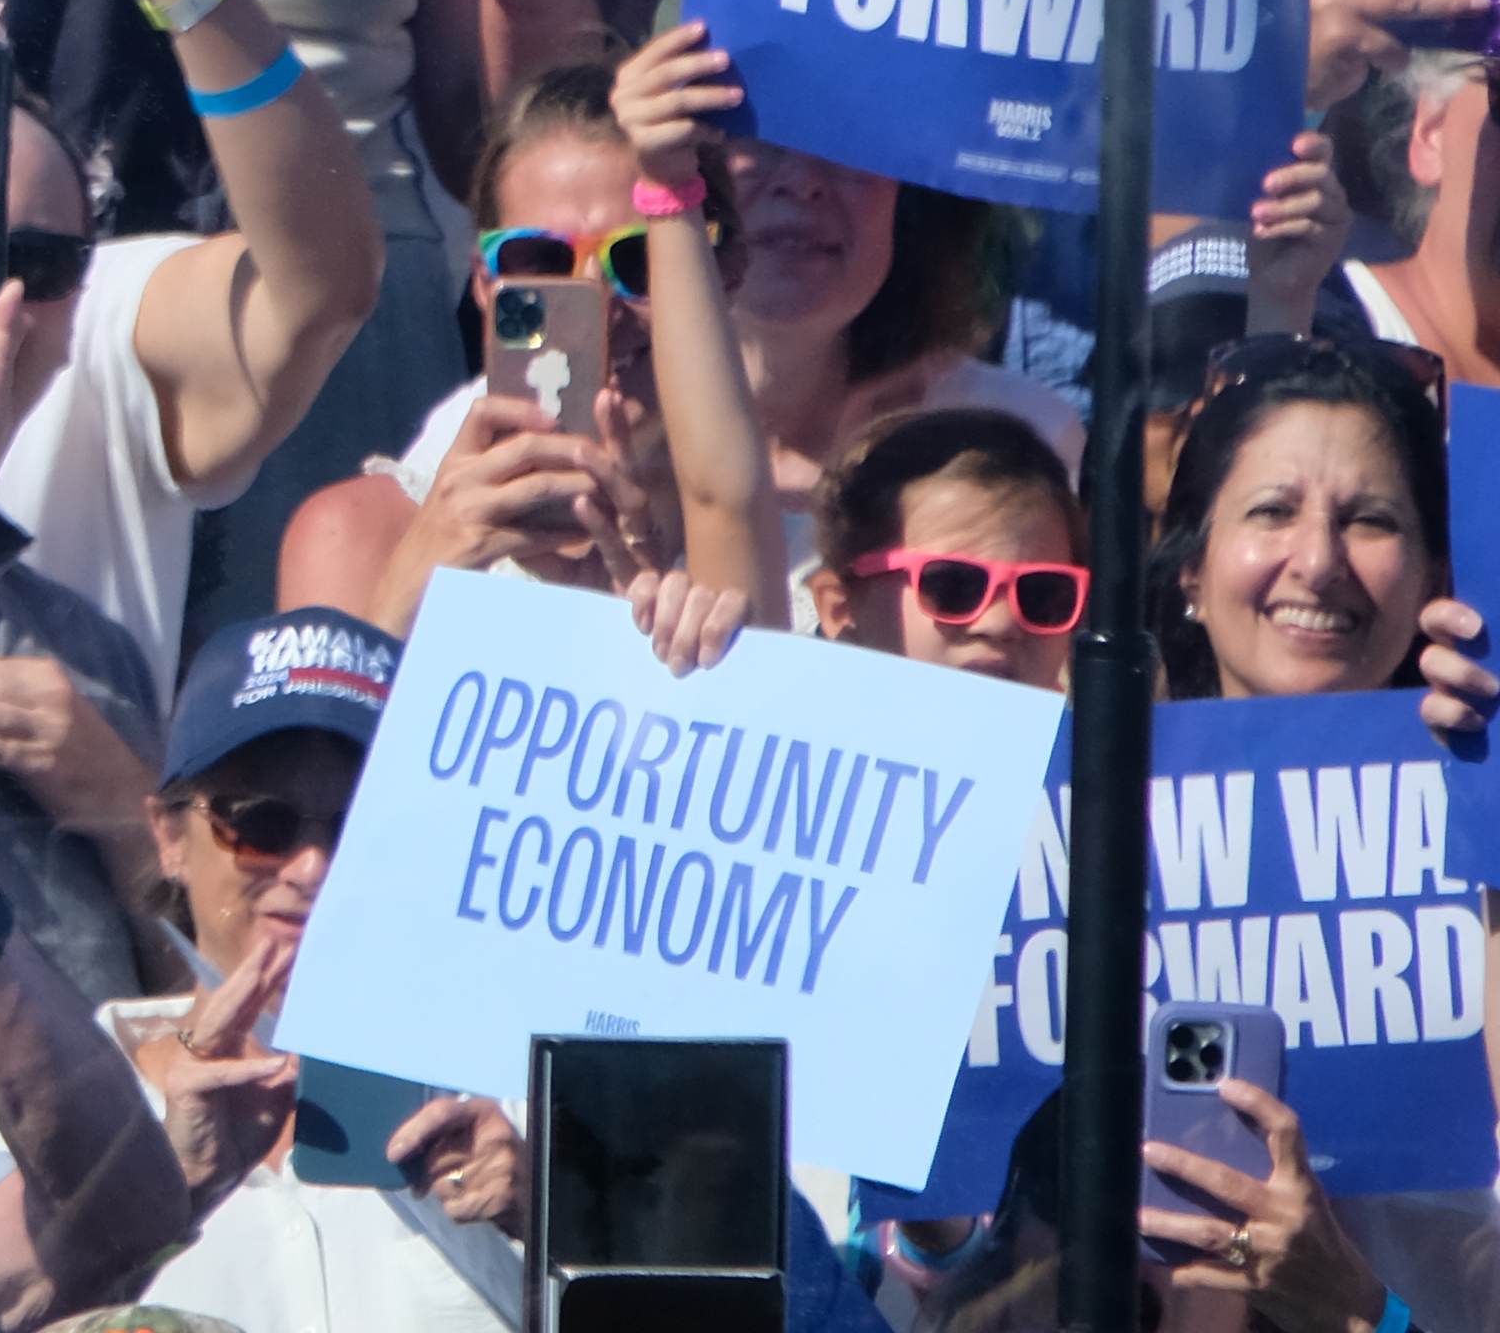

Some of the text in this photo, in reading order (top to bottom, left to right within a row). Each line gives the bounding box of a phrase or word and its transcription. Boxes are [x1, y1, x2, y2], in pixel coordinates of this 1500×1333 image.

[232, 685, 278, 709] FOR
[249, 624, 395, 667] KAMALA
[428, 670, 977, 886] OPPORTUNITY
[457, 806, 861, 994] ECONOMY
